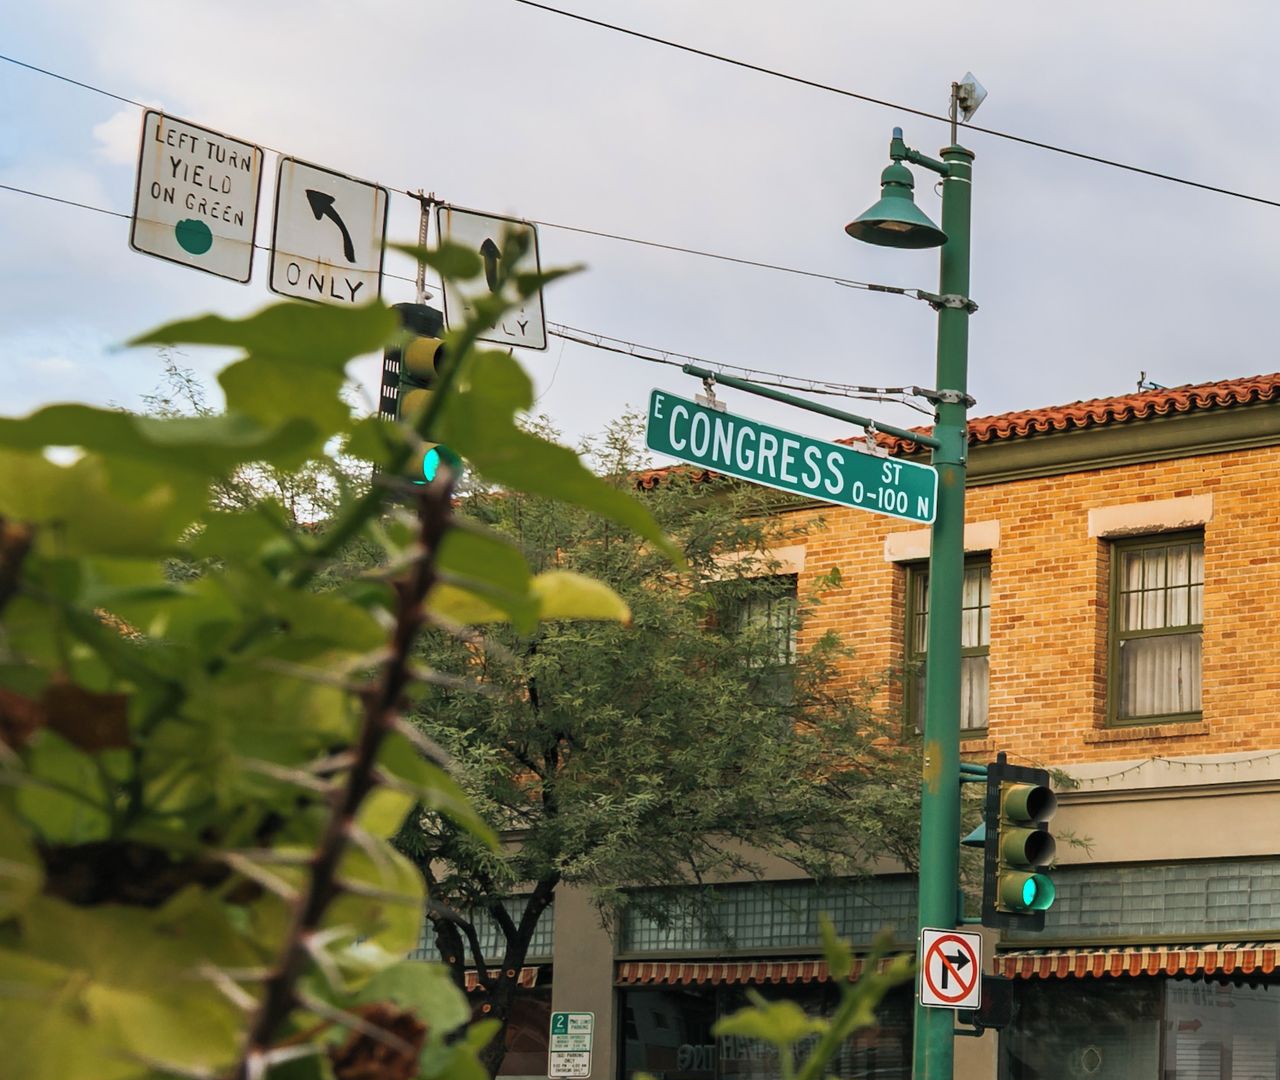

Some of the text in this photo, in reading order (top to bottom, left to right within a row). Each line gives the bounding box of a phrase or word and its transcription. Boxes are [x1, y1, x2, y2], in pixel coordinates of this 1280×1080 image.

[155, 124, 251, 172] LEFT TURN
[170, 156, 232, 194] YIELD
[151, 181, 244, 227] ON GREEN
[286, 262, 364, 303] ONLY
[654, 394, 903, 495] E CONGRESS ST
[852, 481, 929, 518] 0-100 N
[556, 1015, 565, 1028] 2
